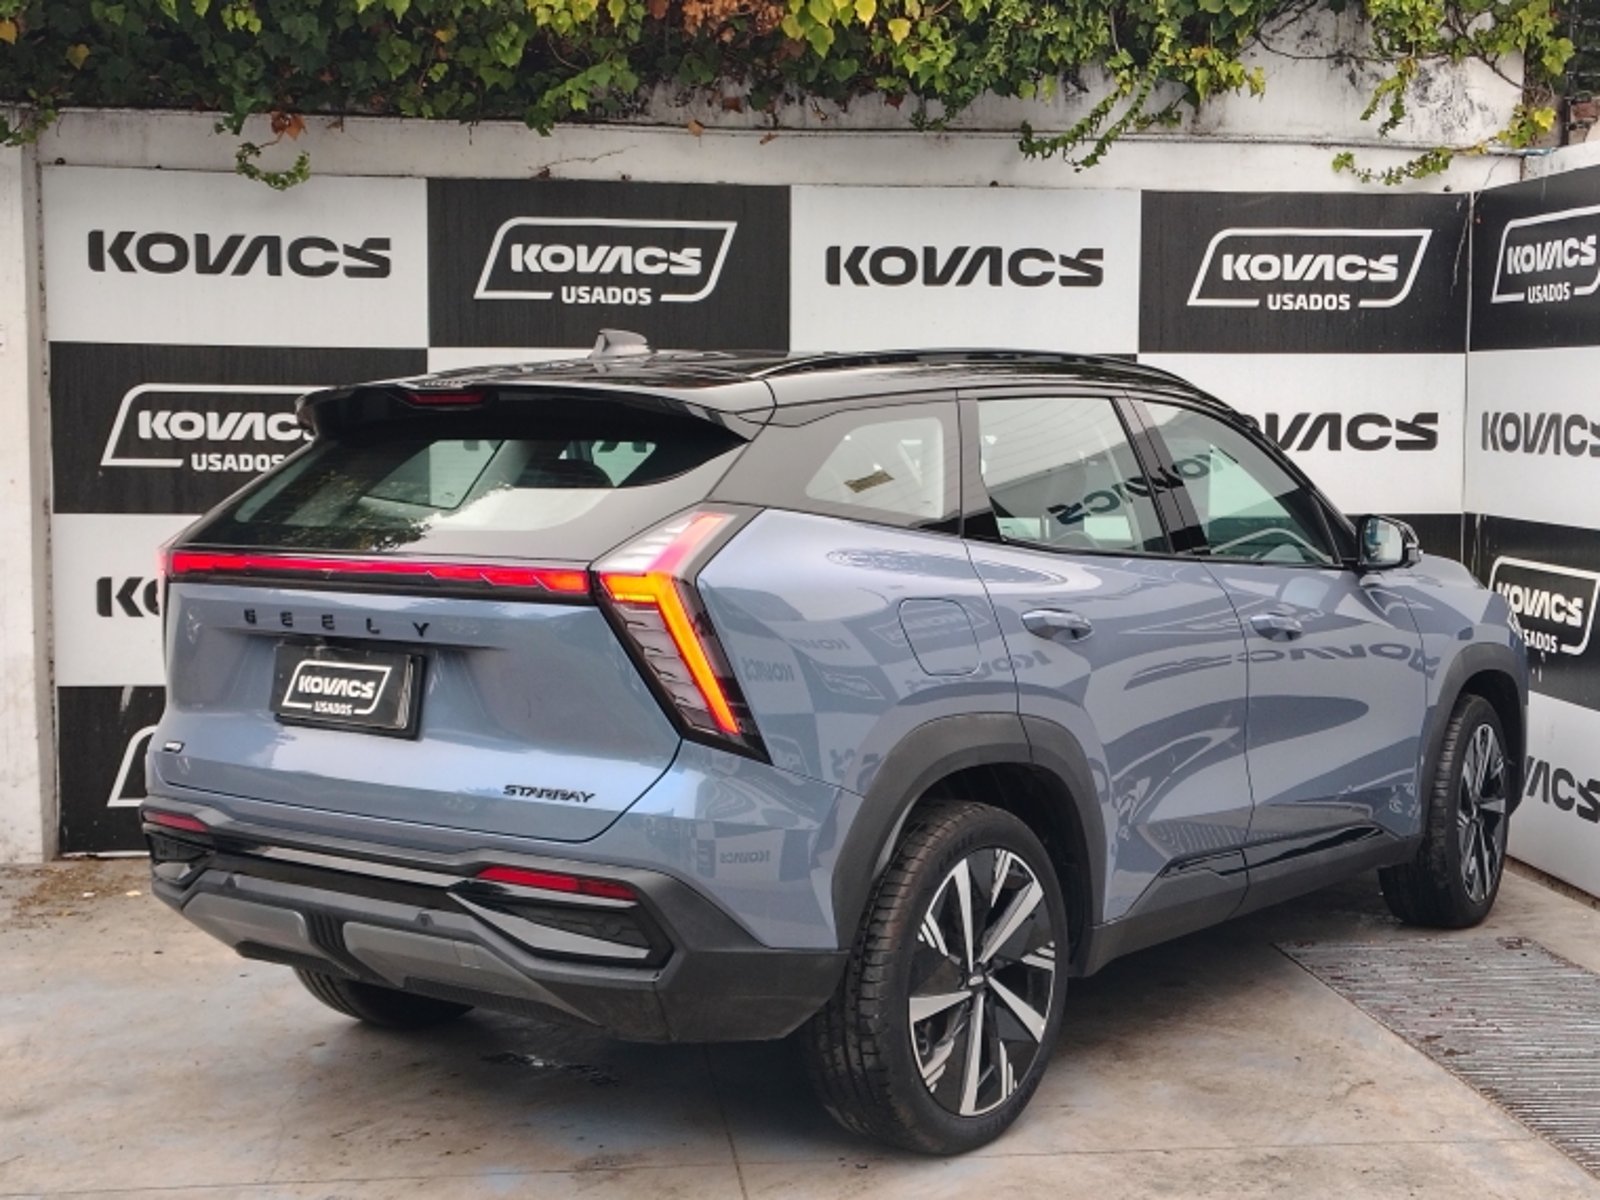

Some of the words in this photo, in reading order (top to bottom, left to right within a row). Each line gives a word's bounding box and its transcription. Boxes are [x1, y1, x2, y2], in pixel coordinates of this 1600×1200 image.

[87, 229, 391, 279] KOVACS
[511, 243, 702, 276] KOVACS
[825, 245, 1104, 287] KOVACS
[1506, 234, 1597, 275] KOVACS
[1222, 254, 1399, 282] KOVACS
[561, 286, 652, 305] USADOS
[1267, 293, 1351, 311] USADOS
[1527, 282, 1571, 304] USADOS
[1243, 412, 1438, 451] VACS
[243, 608, 430, 638] GEELY
[1523, 628, 1557, 654] SADOS
[298, 674, 376, 699] KOVACS
[314, 700, 353, 717] USADOS
[502, 784, 596, 803] STARRAY
